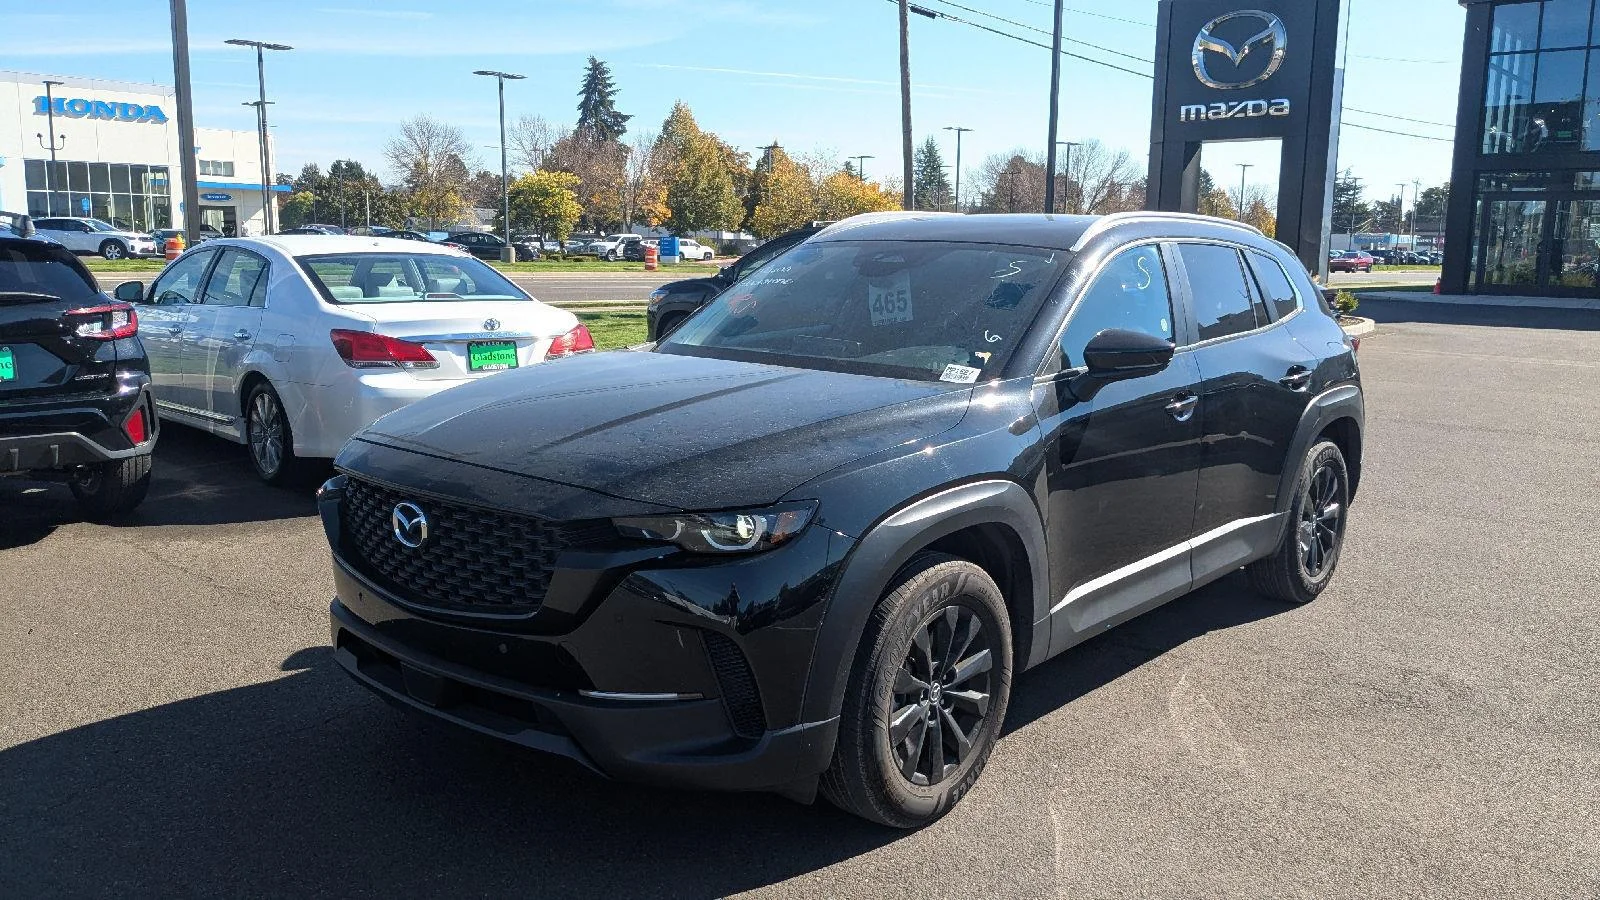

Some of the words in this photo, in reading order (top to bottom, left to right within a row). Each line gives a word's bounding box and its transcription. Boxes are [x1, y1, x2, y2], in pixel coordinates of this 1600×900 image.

[32, 95, 169, 124] HONDA
[872, 290, 908, 314] 465
[472, 352, 516, 362] Gladstone
